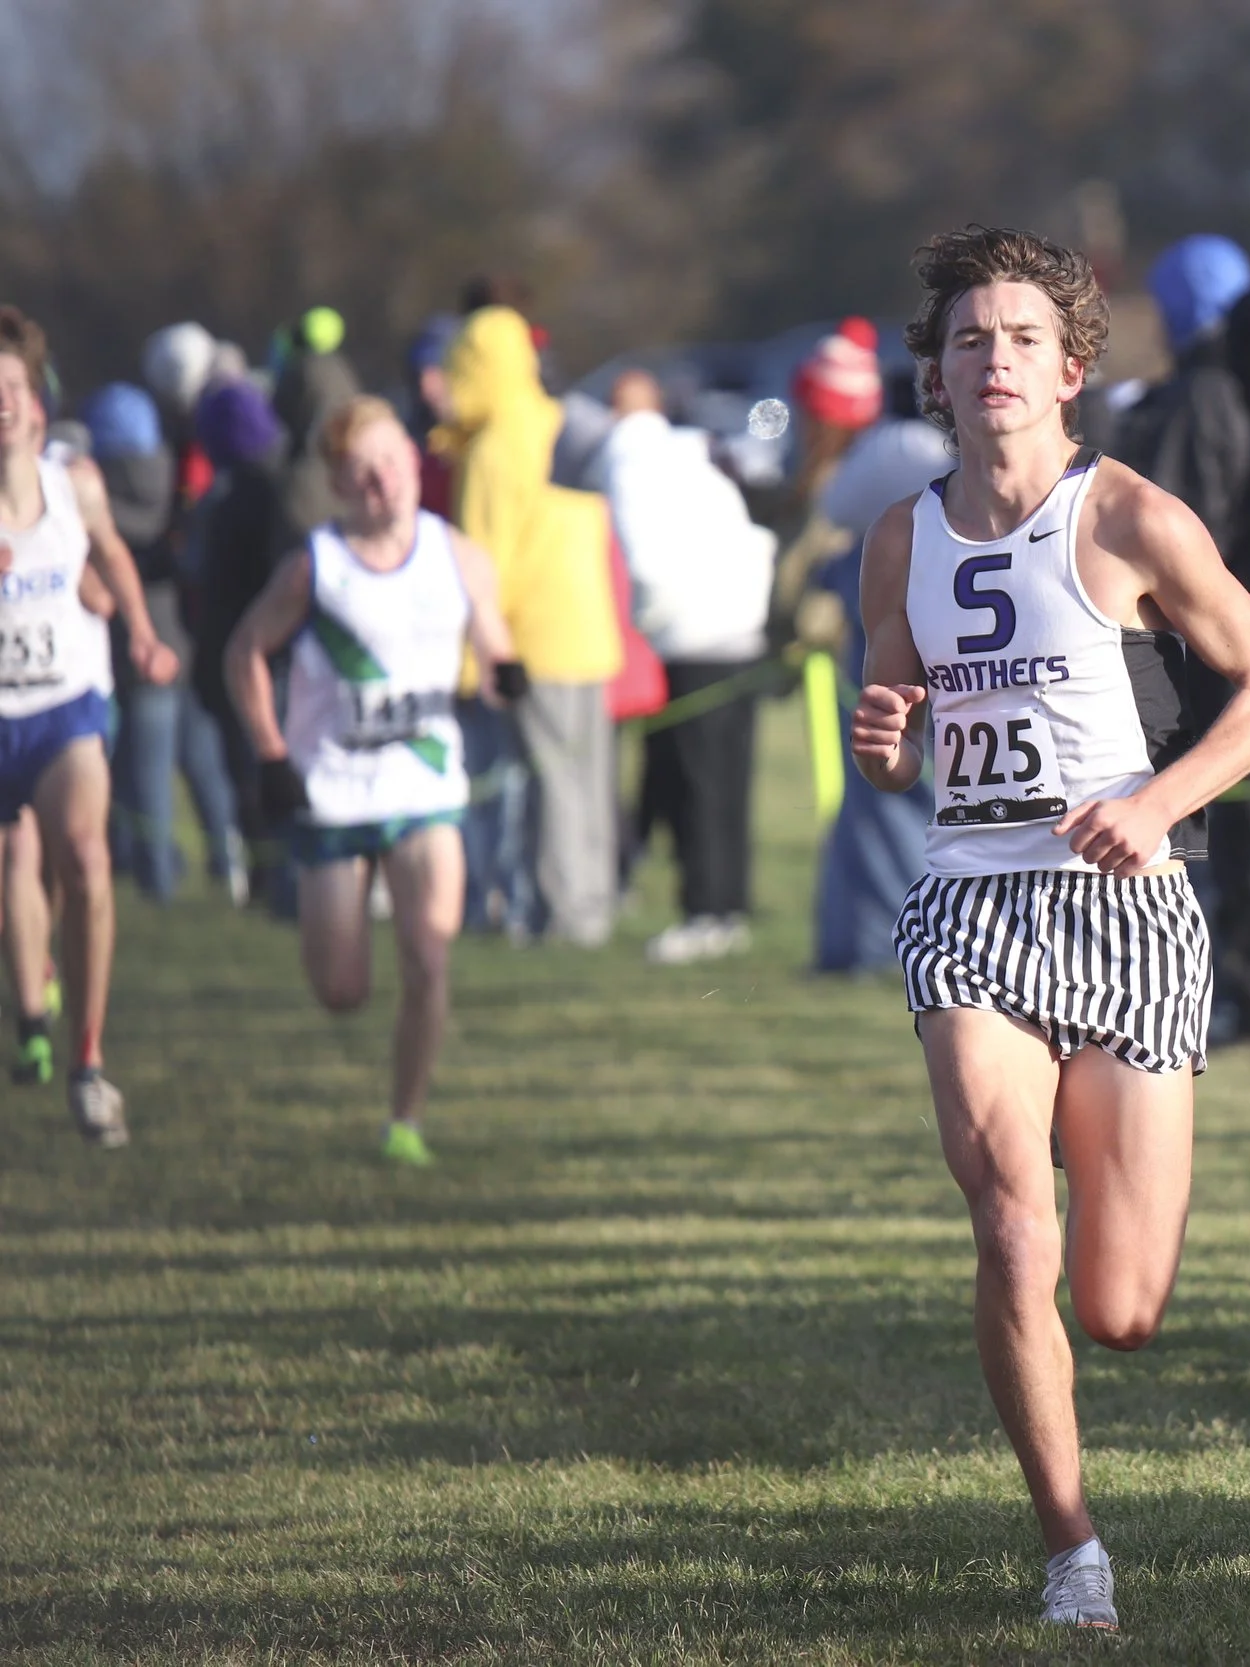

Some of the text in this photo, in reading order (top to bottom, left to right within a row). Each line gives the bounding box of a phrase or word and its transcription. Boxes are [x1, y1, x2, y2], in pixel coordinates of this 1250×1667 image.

[953, 552, 1016, 655] S
[0, 622, 55, 668] 53
[944, 717, 1042, 787] 225
